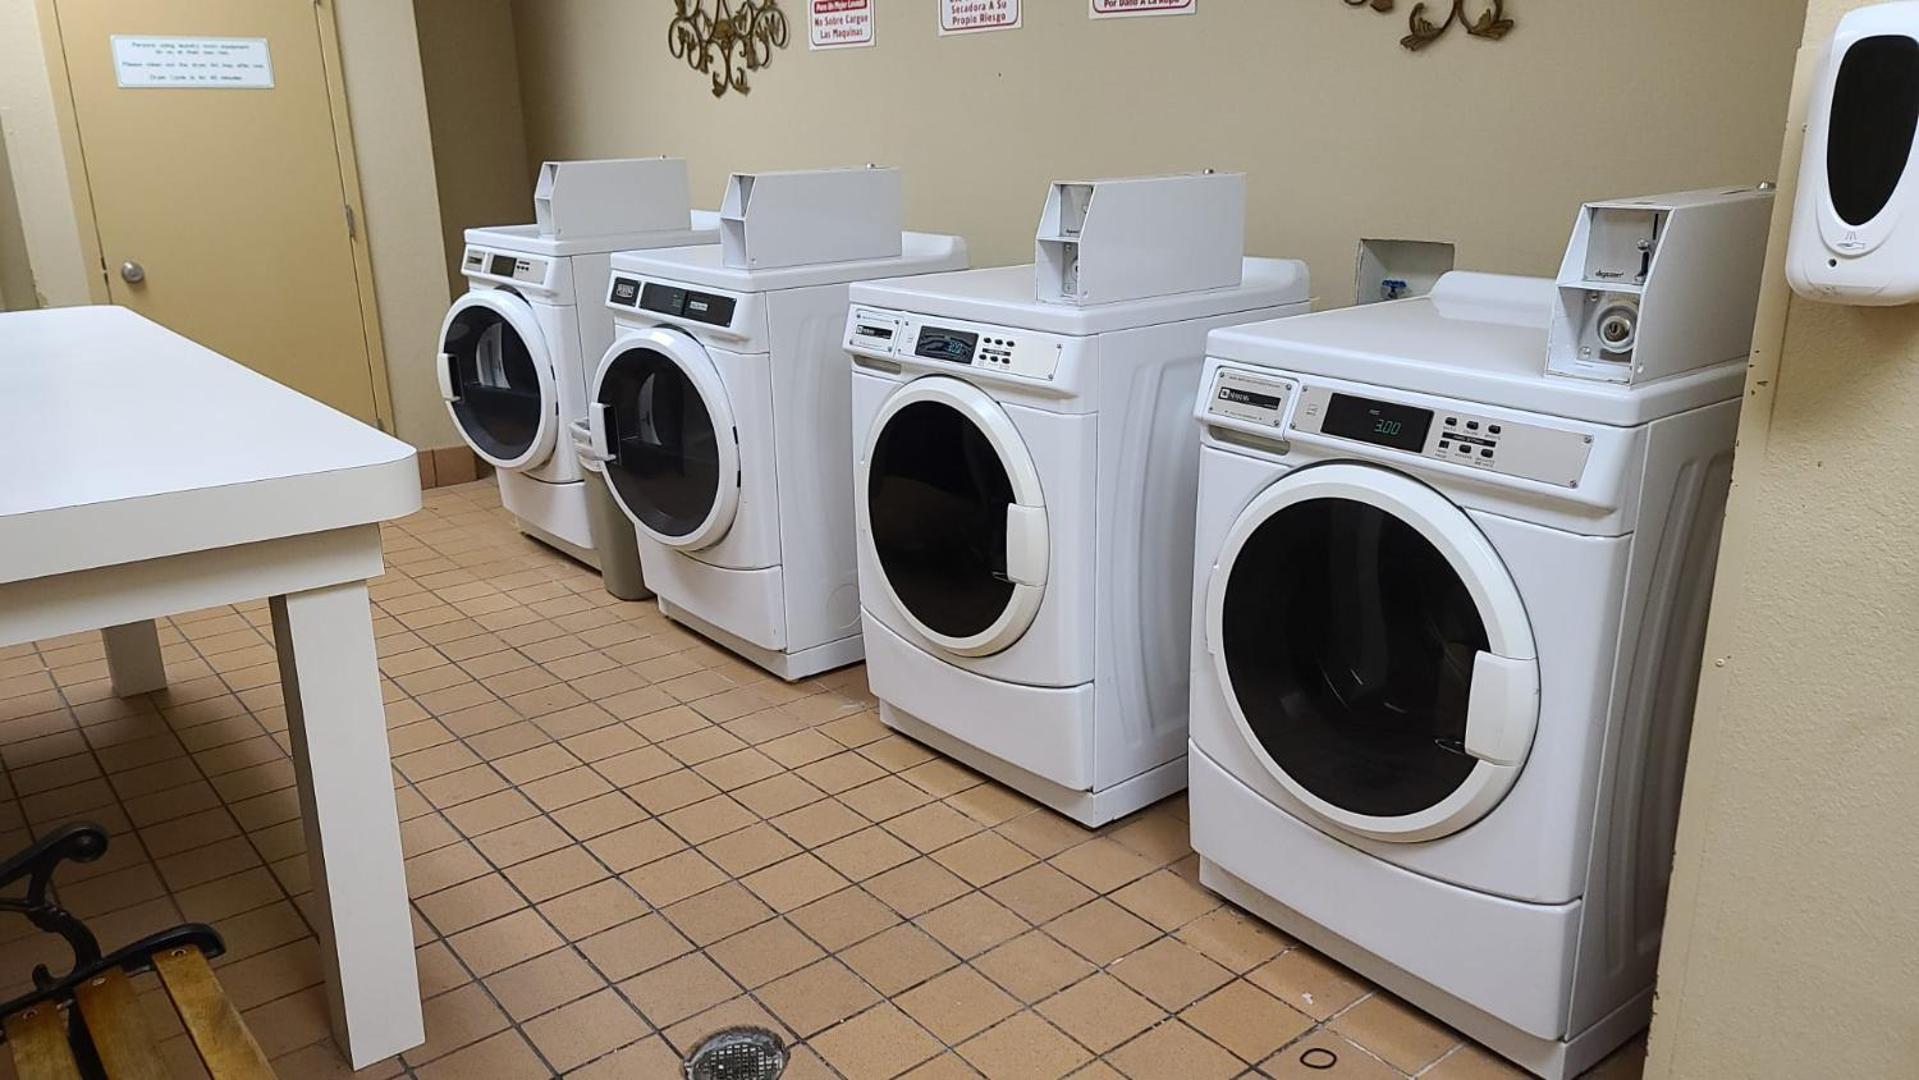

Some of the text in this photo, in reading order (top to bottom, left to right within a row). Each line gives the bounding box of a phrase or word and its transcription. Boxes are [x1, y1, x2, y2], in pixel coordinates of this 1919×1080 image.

[951, 1, 1007, 14] Secadora A Su
[1104, 0, 1117, 8] Por
[814, 15, 868, 26] No Sobre Cargue
[952, 13, 1006, 25] Propio Riesgo
[820, 29, 831, 39] Las
